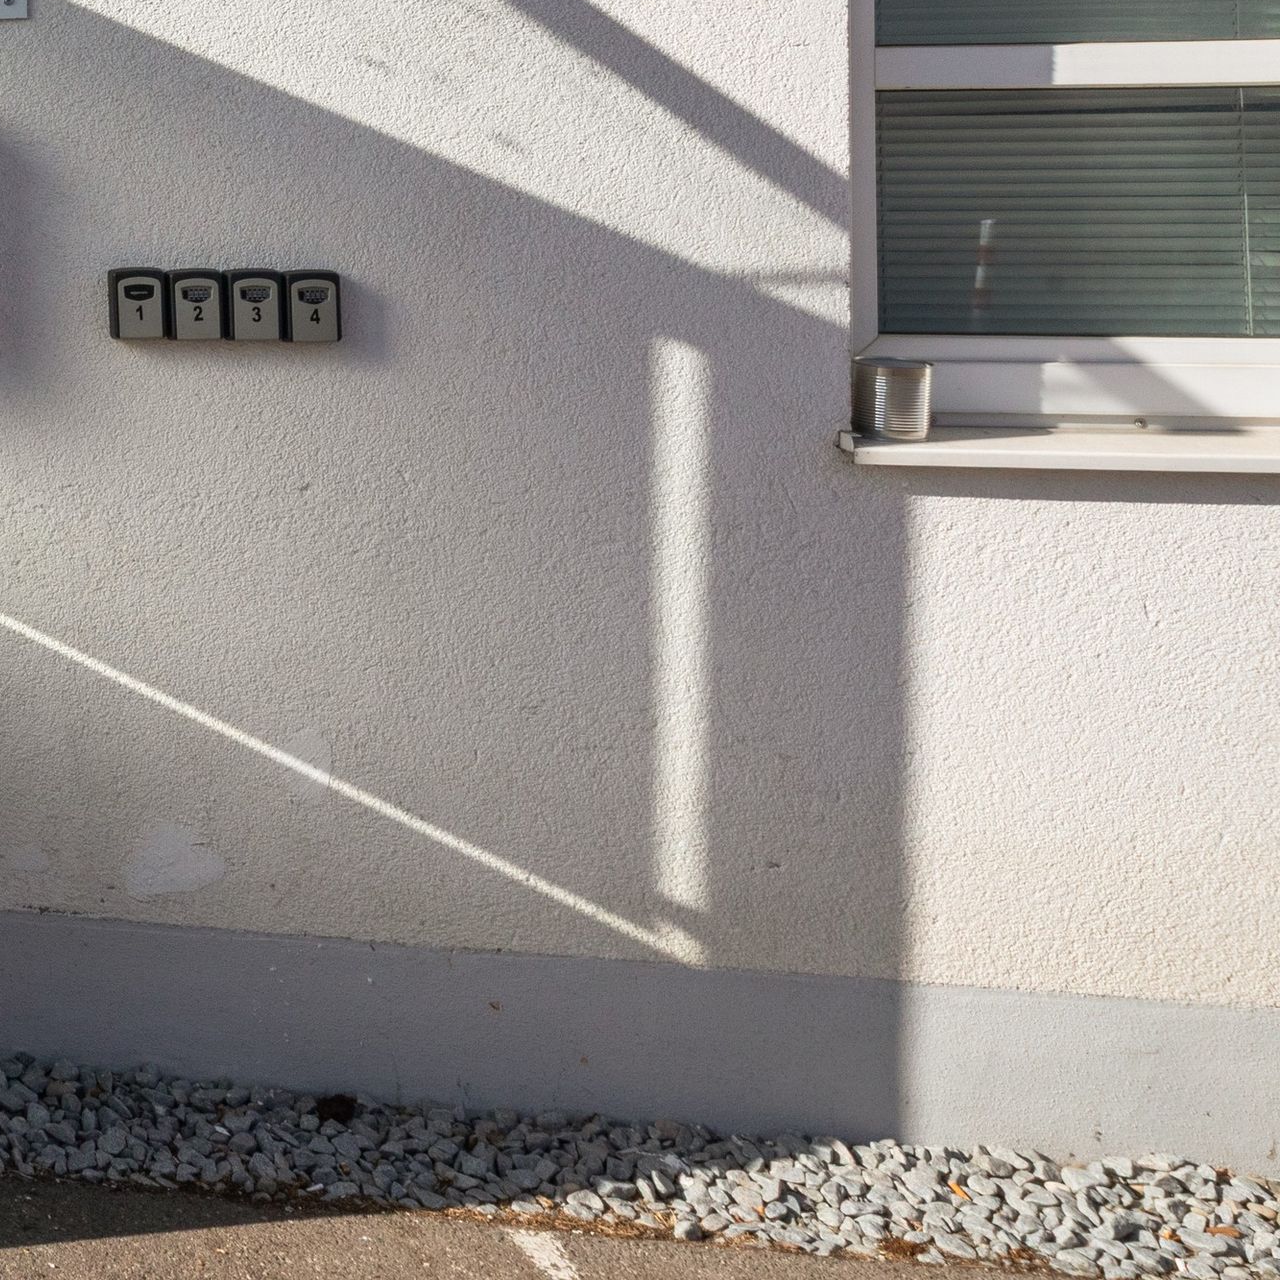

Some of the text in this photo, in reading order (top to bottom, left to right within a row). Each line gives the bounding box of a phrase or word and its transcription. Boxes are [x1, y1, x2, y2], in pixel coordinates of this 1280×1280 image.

[135, 305, 144, 321] 1
[193, 306, 204, 322] 2
[252, 307, 262, 323] 3
[310, 308, 321, 324] 4
